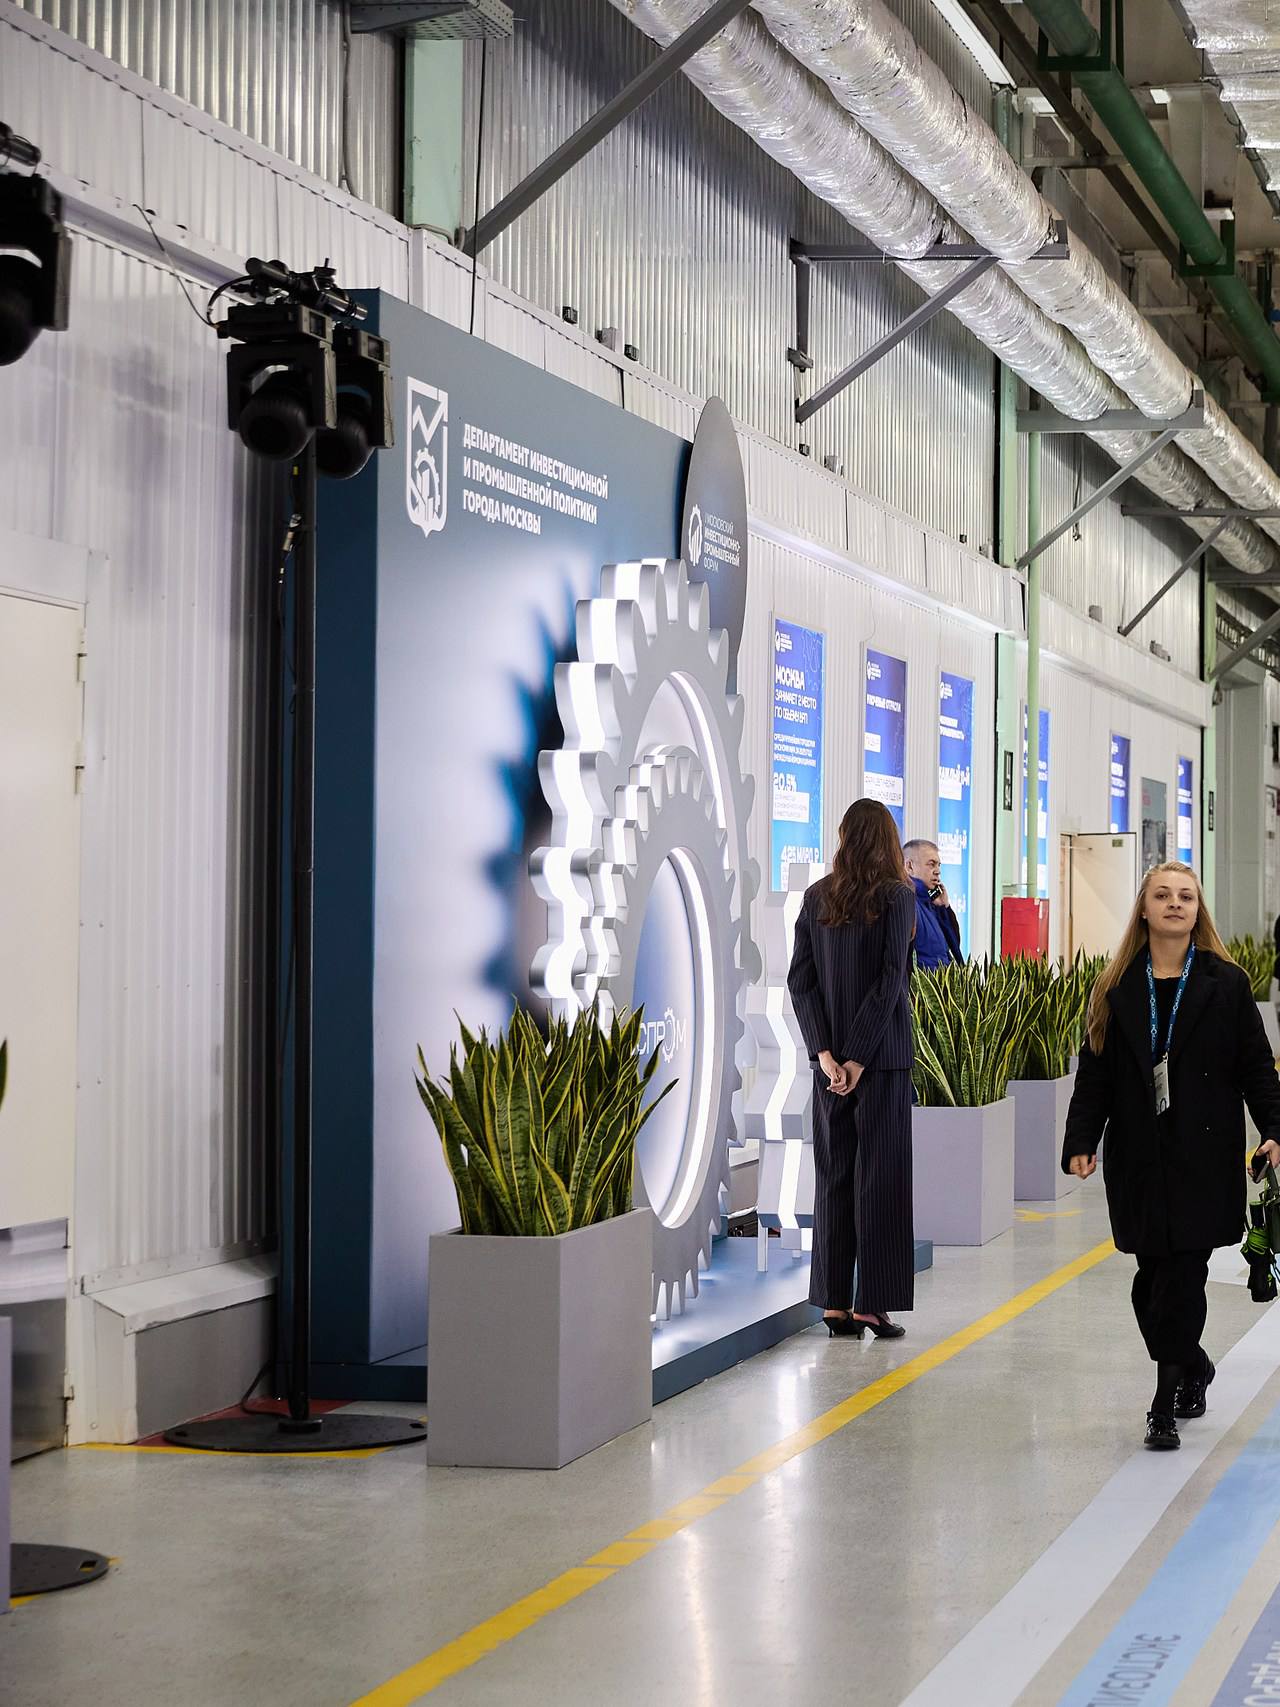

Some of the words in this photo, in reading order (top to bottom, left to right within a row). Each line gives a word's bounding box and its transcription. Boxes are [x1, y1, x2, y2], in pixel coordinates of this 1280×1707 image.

[463, 423, 529, 468] ДЕПАРТАМЕНТ
[530, 449, 608, 500] ИНВЕСТИЦИОННОЙ
[463, 456, 471, 478] И
[472, 457, 552, 508] ПРОМЫШЛЕННОЙ
[553, 494, 597, 525] ПОЛИТИКИ
[463, 489, 500, 524] ГОРОДА
[501, 502, 541, 535] МОСКВЫ
[775, 664, 806, 691] МОСКВА
